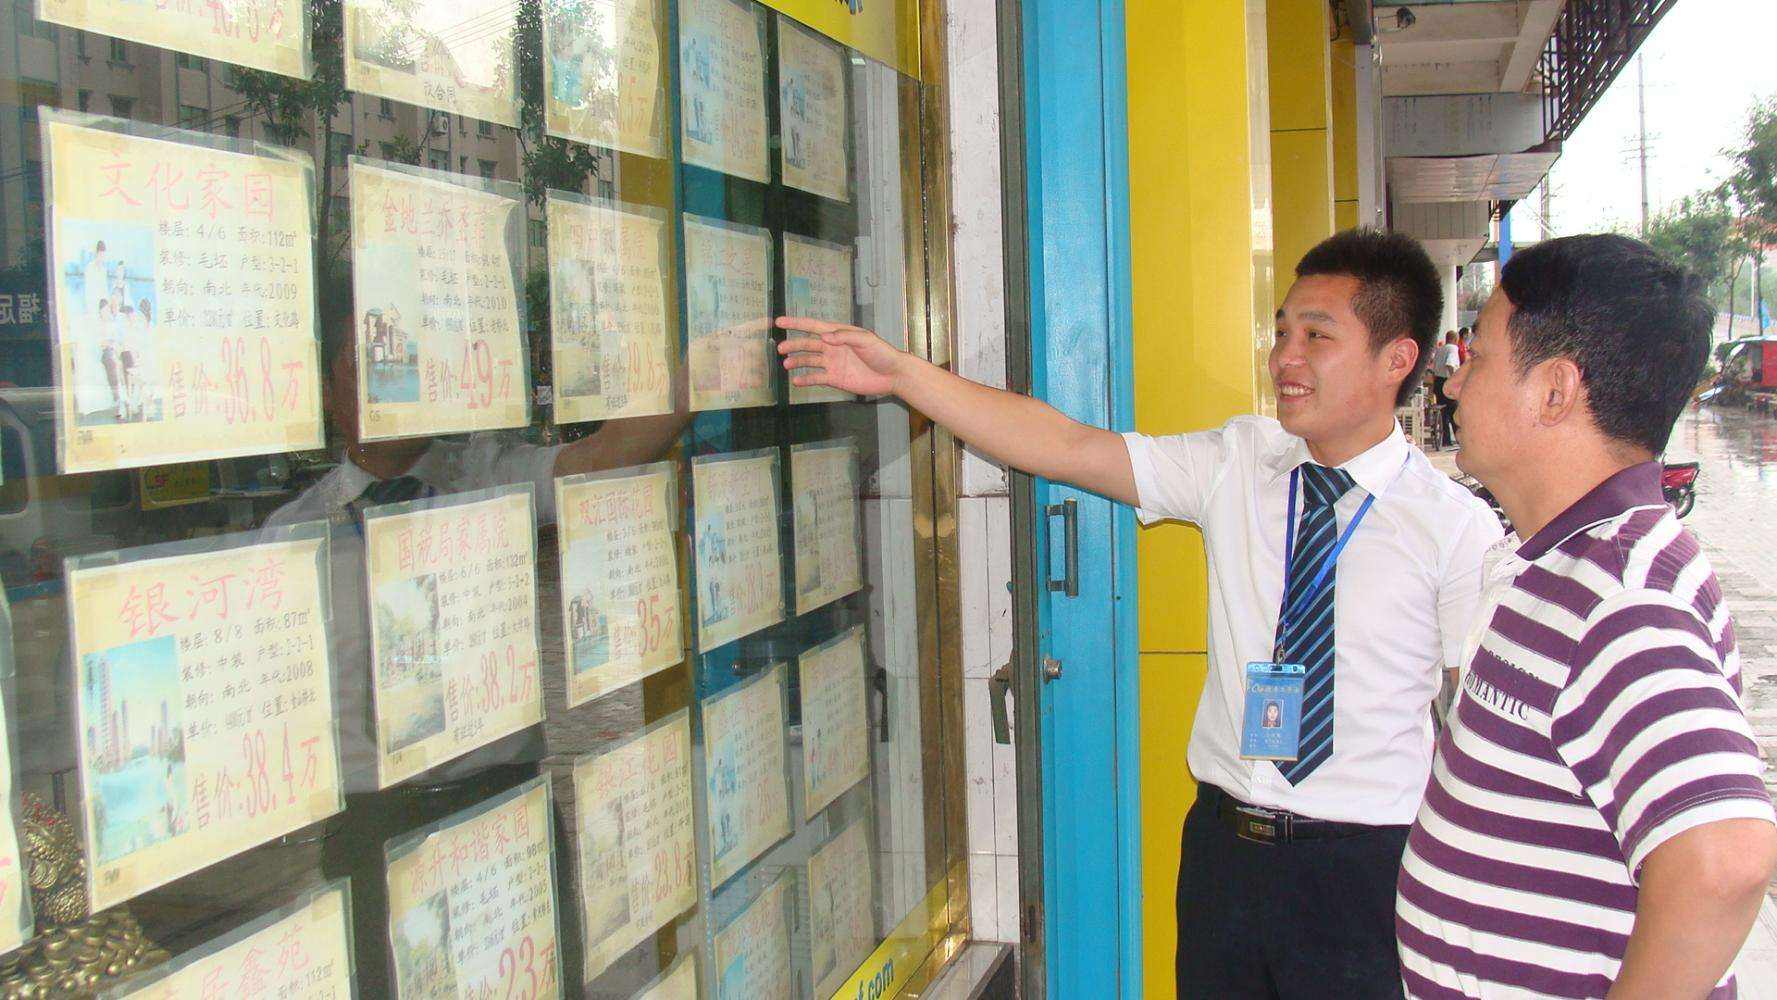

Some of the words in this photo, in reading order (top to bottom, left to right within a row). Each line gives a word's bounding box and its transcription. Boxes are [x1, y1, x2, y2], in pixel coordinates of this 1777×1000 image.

[99, 148, 274, 222] 文化家园
[169, 336, 303, 425] 售价:36.8万
[118, 557, 286, 638] 银河湾
[192, 722, 321, 831] 售价:38.4万
